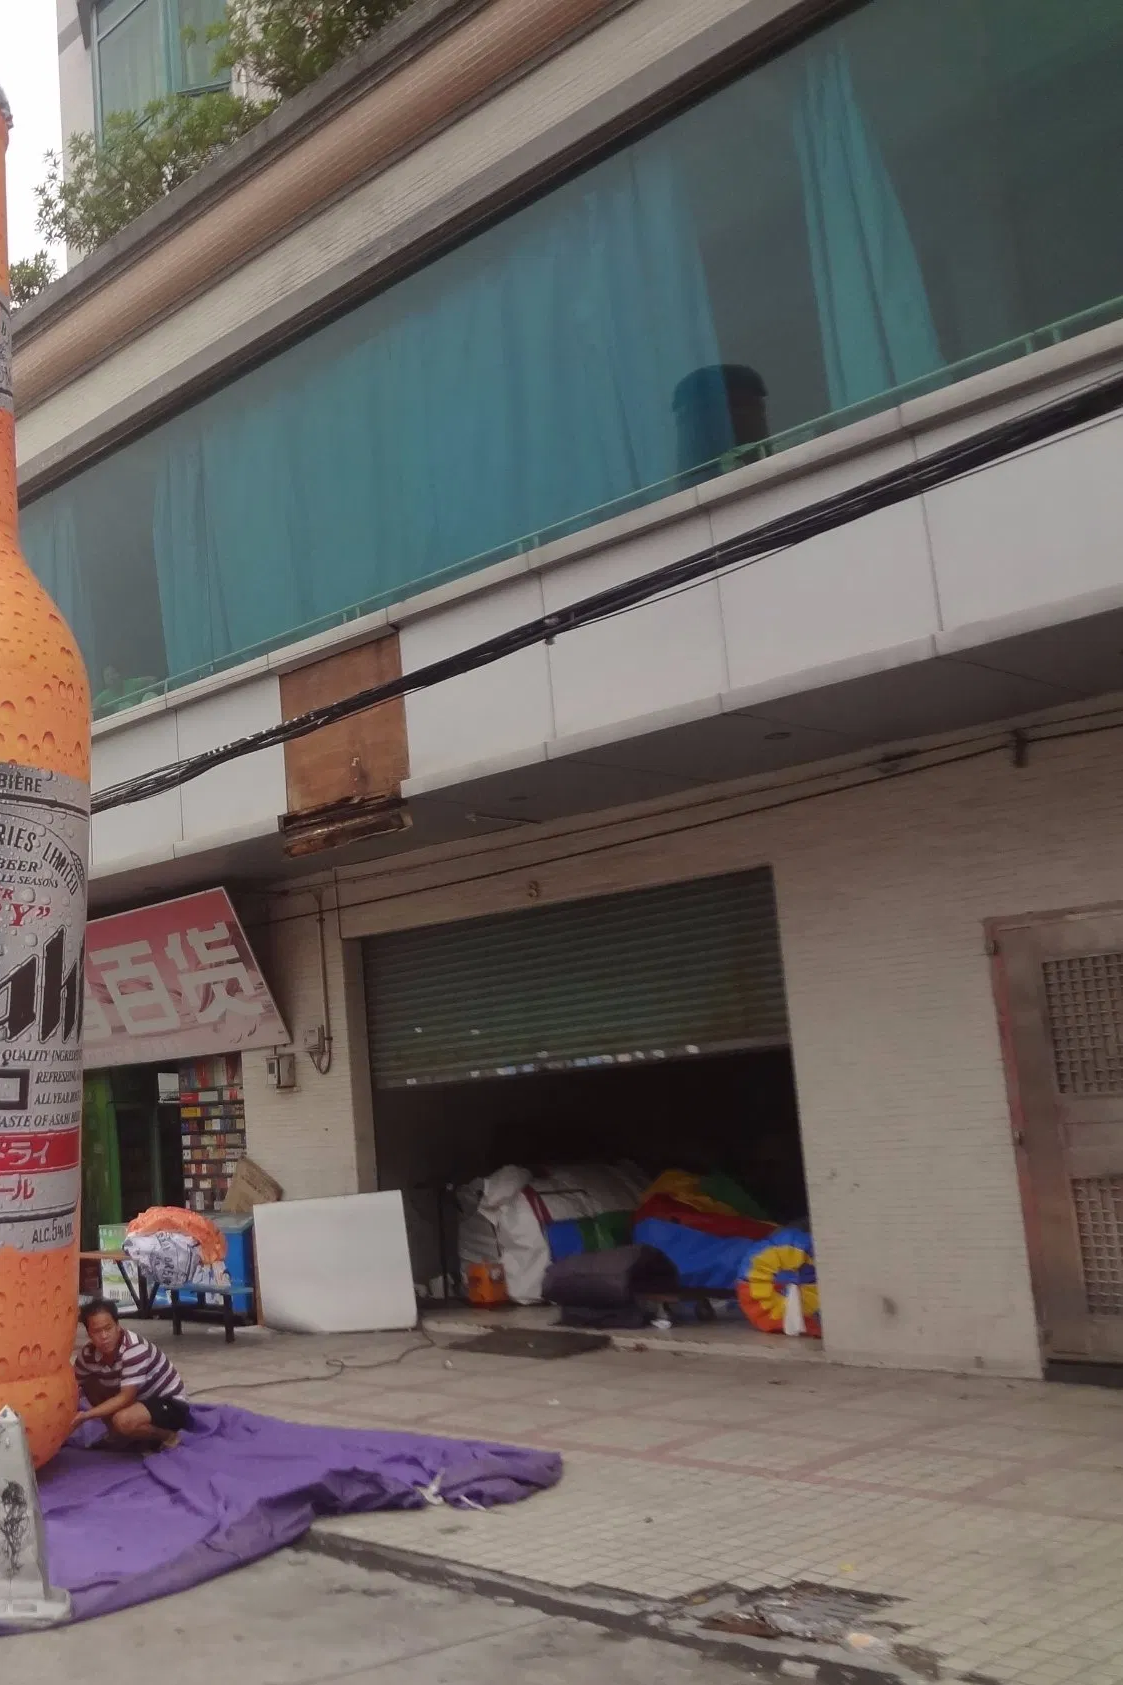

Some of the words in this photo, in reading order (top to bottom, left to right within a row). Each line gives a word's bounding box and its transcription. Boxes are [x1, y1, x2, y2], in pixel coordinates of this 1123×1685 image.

[42, 841, 79, 896] LIMITED
[17, 875, 59, 889] SEASONS
[83, 922, 265, 1039] 百货
[1, 1049, 50, 1066] QUALITY
[34, 1092, 51, 1105] ALL
[34, 1114, 48, 1127] OF
